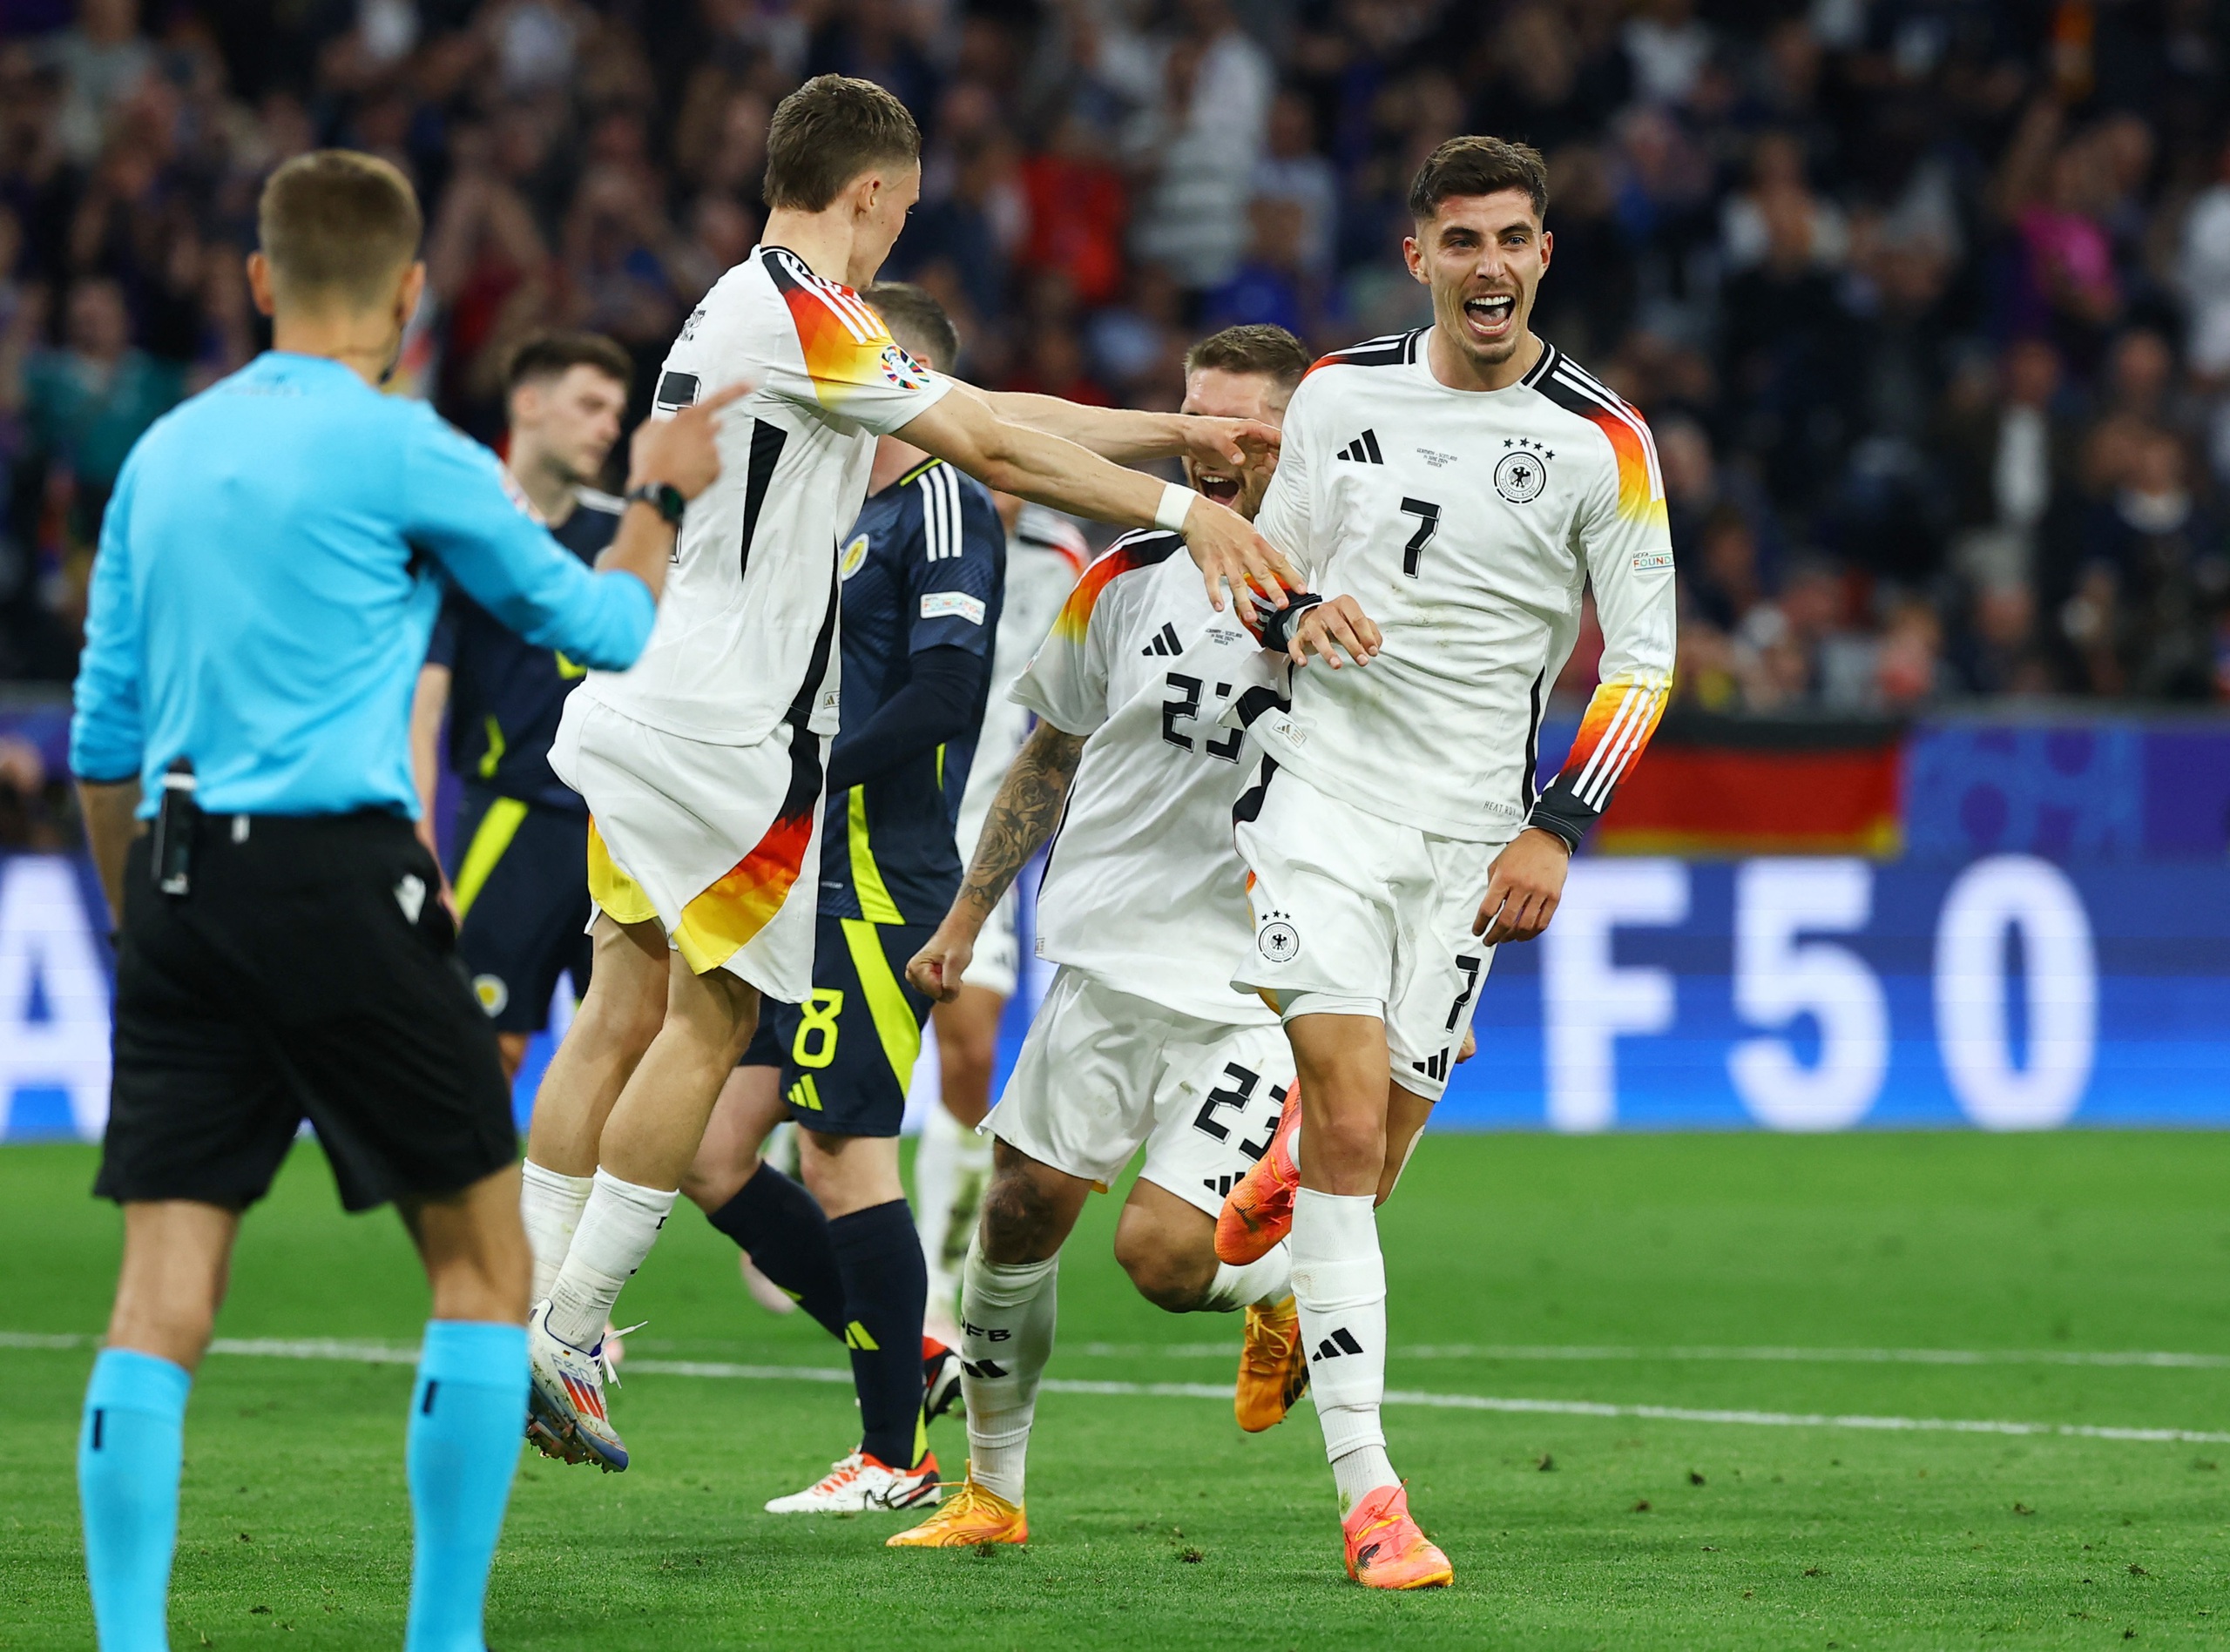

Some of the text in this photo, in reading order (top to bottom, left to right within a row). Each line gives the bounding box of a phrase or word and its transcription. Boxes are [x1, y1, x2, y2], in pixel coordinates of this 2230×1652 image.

[1509, 458, 1537, 471] DEUTSCHER
[1400, 496, 1443, 579] 7
[1633, 556, 1673, 568] FOUND
[1445, 954, 1481, 1034] 7
[792, 988, 845, 1069] 8
[962, 1316, 1011, 1342] FB
